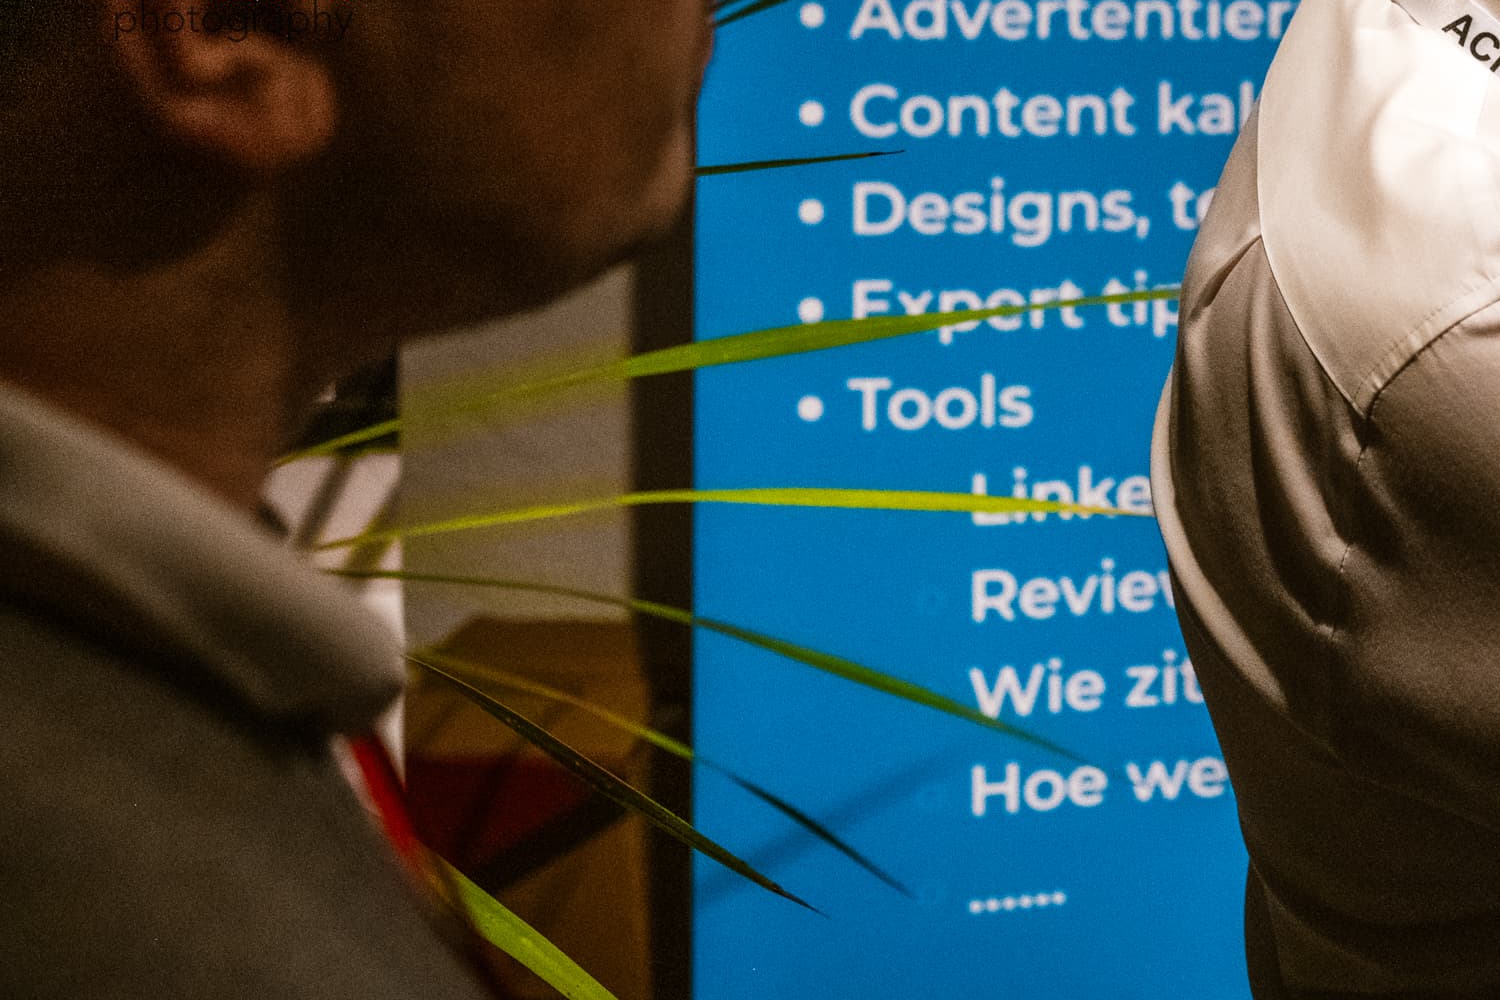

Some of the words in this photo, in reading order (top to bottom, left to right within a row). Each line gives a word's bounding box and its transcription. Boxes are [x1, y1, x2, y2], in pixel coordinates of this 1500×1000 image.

[848, 82, 1137, 139] Content
[851, 175, 1151, 248] Designs,
[851, 278, 1085, 345] Expert
[845, 372, 1035, 432] Tools
[968, 656, 1107, 720] Wie
[970, 761, 1109, 817] Hoe
[1125, 756, 1229, 803] we
